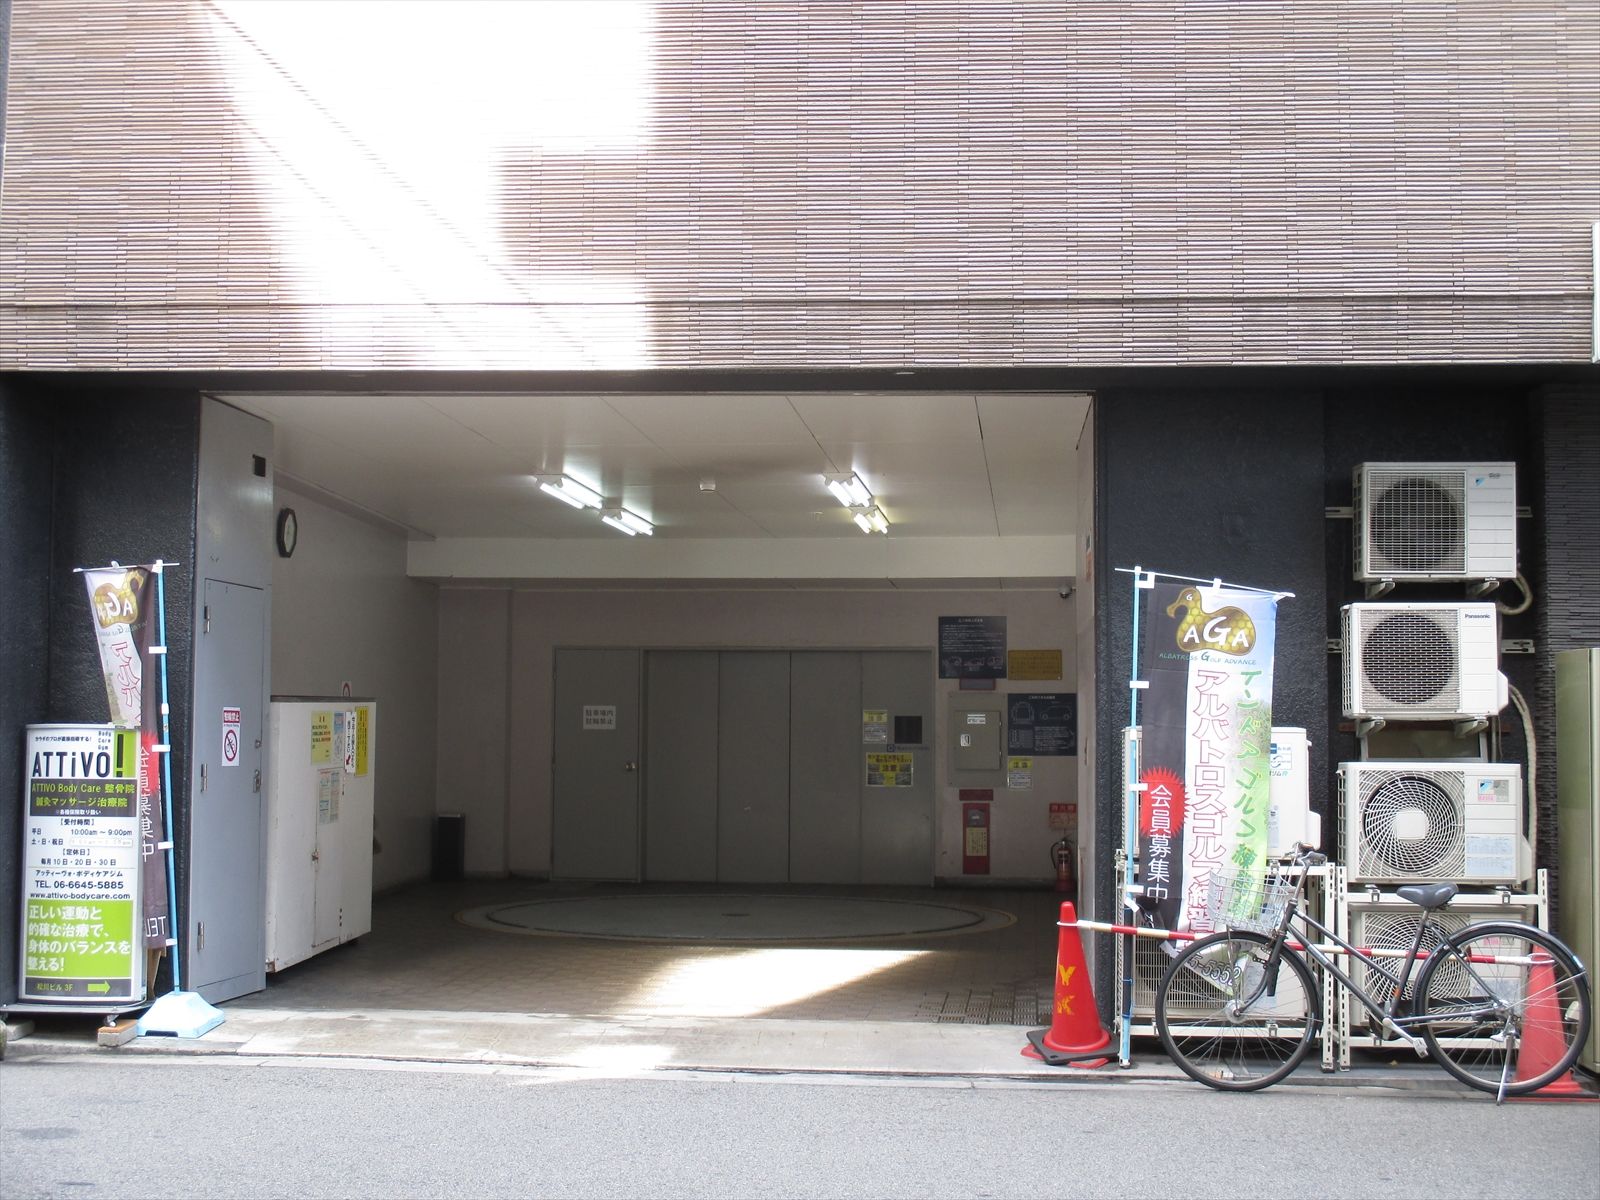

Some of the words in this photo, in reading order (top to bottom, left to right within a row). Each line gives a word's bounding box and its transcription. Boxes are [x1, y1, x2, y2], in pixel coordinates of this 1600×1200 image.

[1183, 616, 1249, 648] AGA
[1224, 658, 1257, 666] ADVANCE
[32, 783, 55, 793] ATTIVO
[58, 783, 78, 794] Body
[80, 783, 101, 793] Care
[104, 783, 136, 794] 整骨院
[108, 829, 133, 837] 9:00pm
[1146, 784, 1173, 904] 会員募集中
[35, 880, 51, 889] TEL.
[54, 880, 124, 889] 06-6645-5885
[30, 892, 131, 900] www.attivo-bodycare.com
[29, 905, 102, 921] 正しい運動と
[28, 923, 110, 937] 的確な治療で、
[28, 940, 131, 955] 身体のバランスを
[64, 983, 73, 992] 3F
